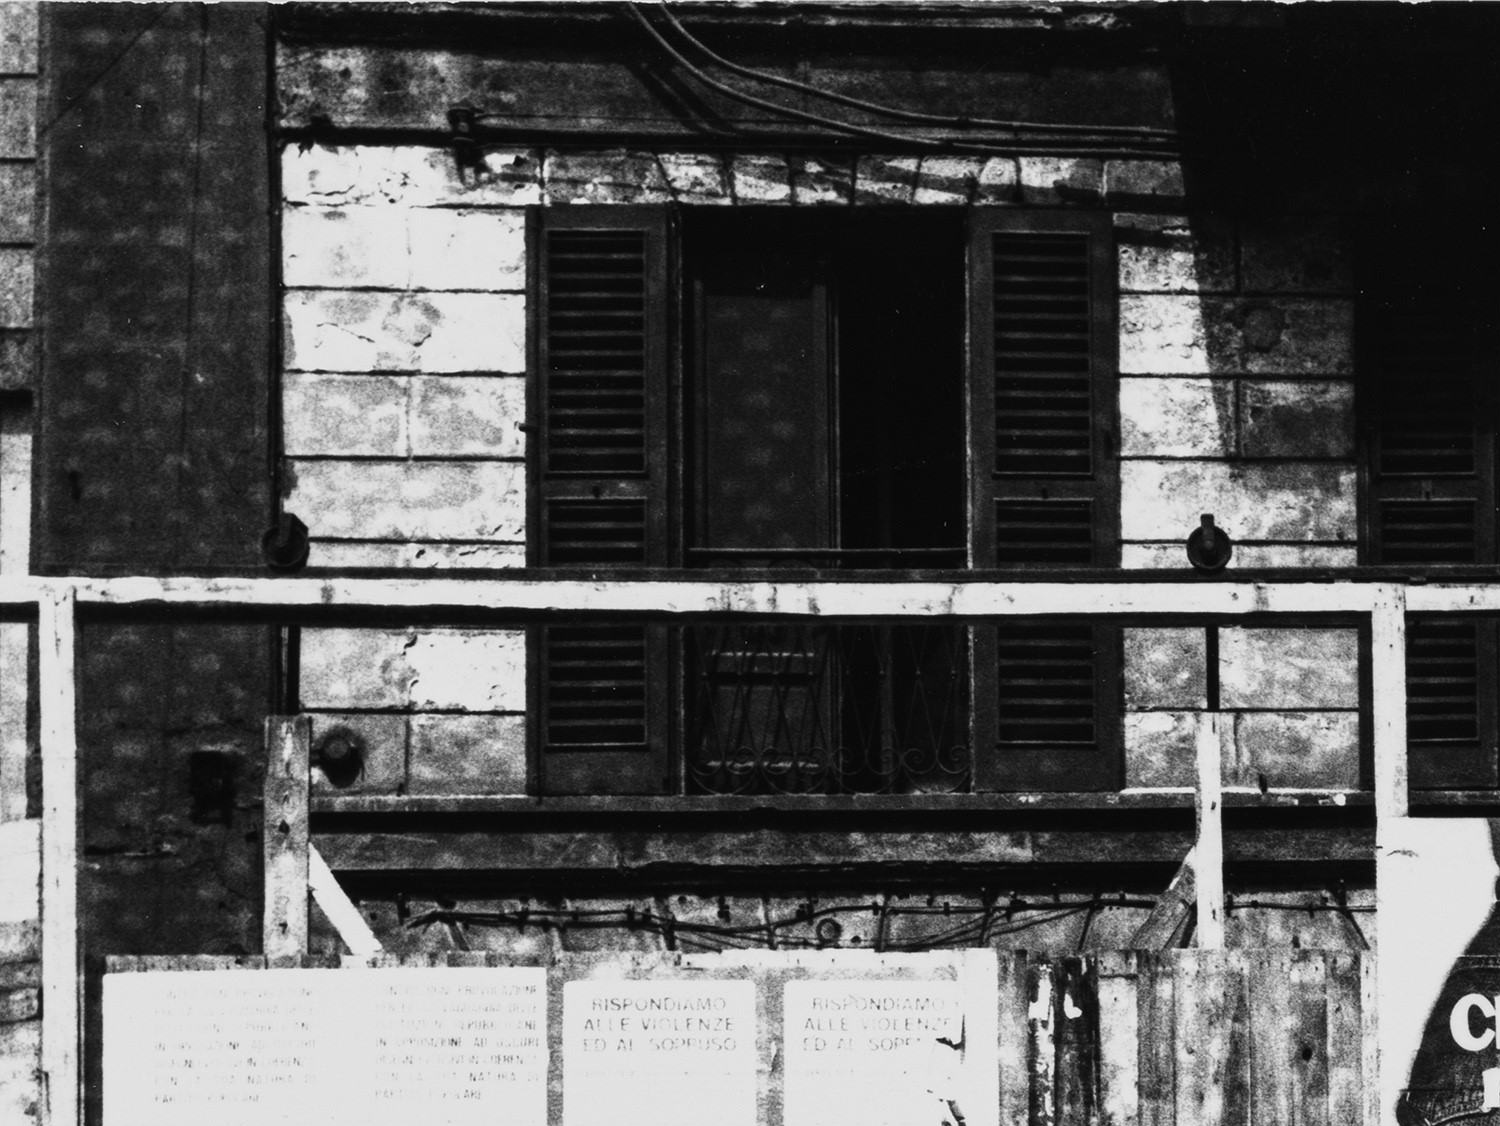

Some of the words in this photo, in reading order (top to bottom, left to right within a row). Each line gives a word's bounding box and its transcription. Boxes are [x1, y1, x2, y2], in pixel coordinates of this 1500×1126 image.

[592, 997, 726, 1012] RISPONDIAMO
[812, 997, 945, 1012] RISPONDIAMO
[584, 1017, 629, 1032] ALLE
[642, 1016, 735, 1032] VIOLENZE
[804, 1017, 848, 1031] ALLE
[583, 1038, 607, 1052] ED
[616, 1038, 634, 1052] AL
[649, 1037, 737, 1052] SOPRUSO
[803, 1037, 827, 1051] ED
